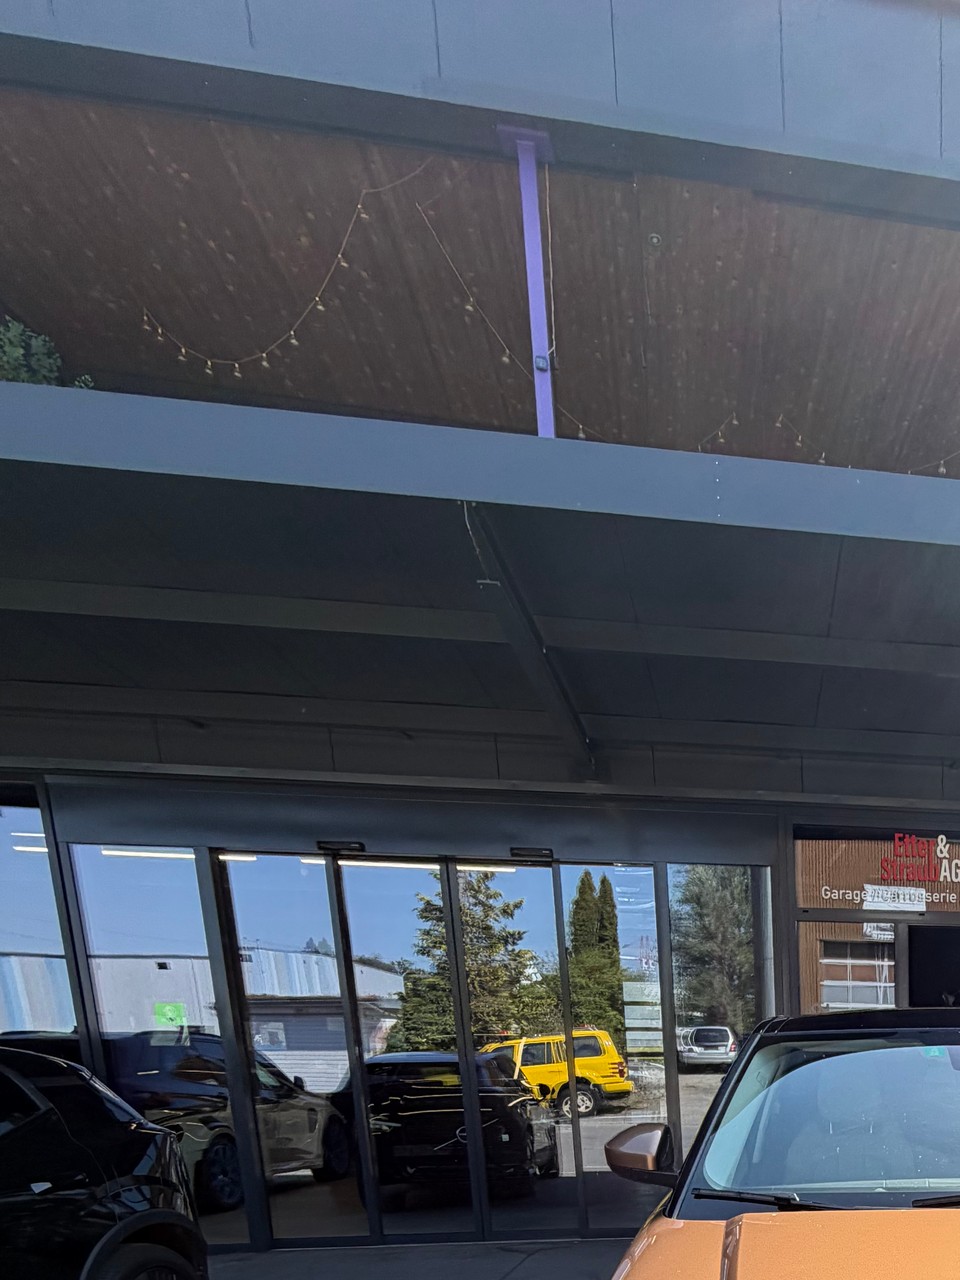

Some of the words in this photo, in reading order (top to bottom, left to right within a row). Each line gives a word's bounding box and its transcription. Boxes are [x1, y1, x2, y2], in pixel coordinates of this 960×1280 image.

[893, 832, 936, 858] Etter
[880, 856, 940, 882] Straub
[821, 885, 868, 903] Garage
